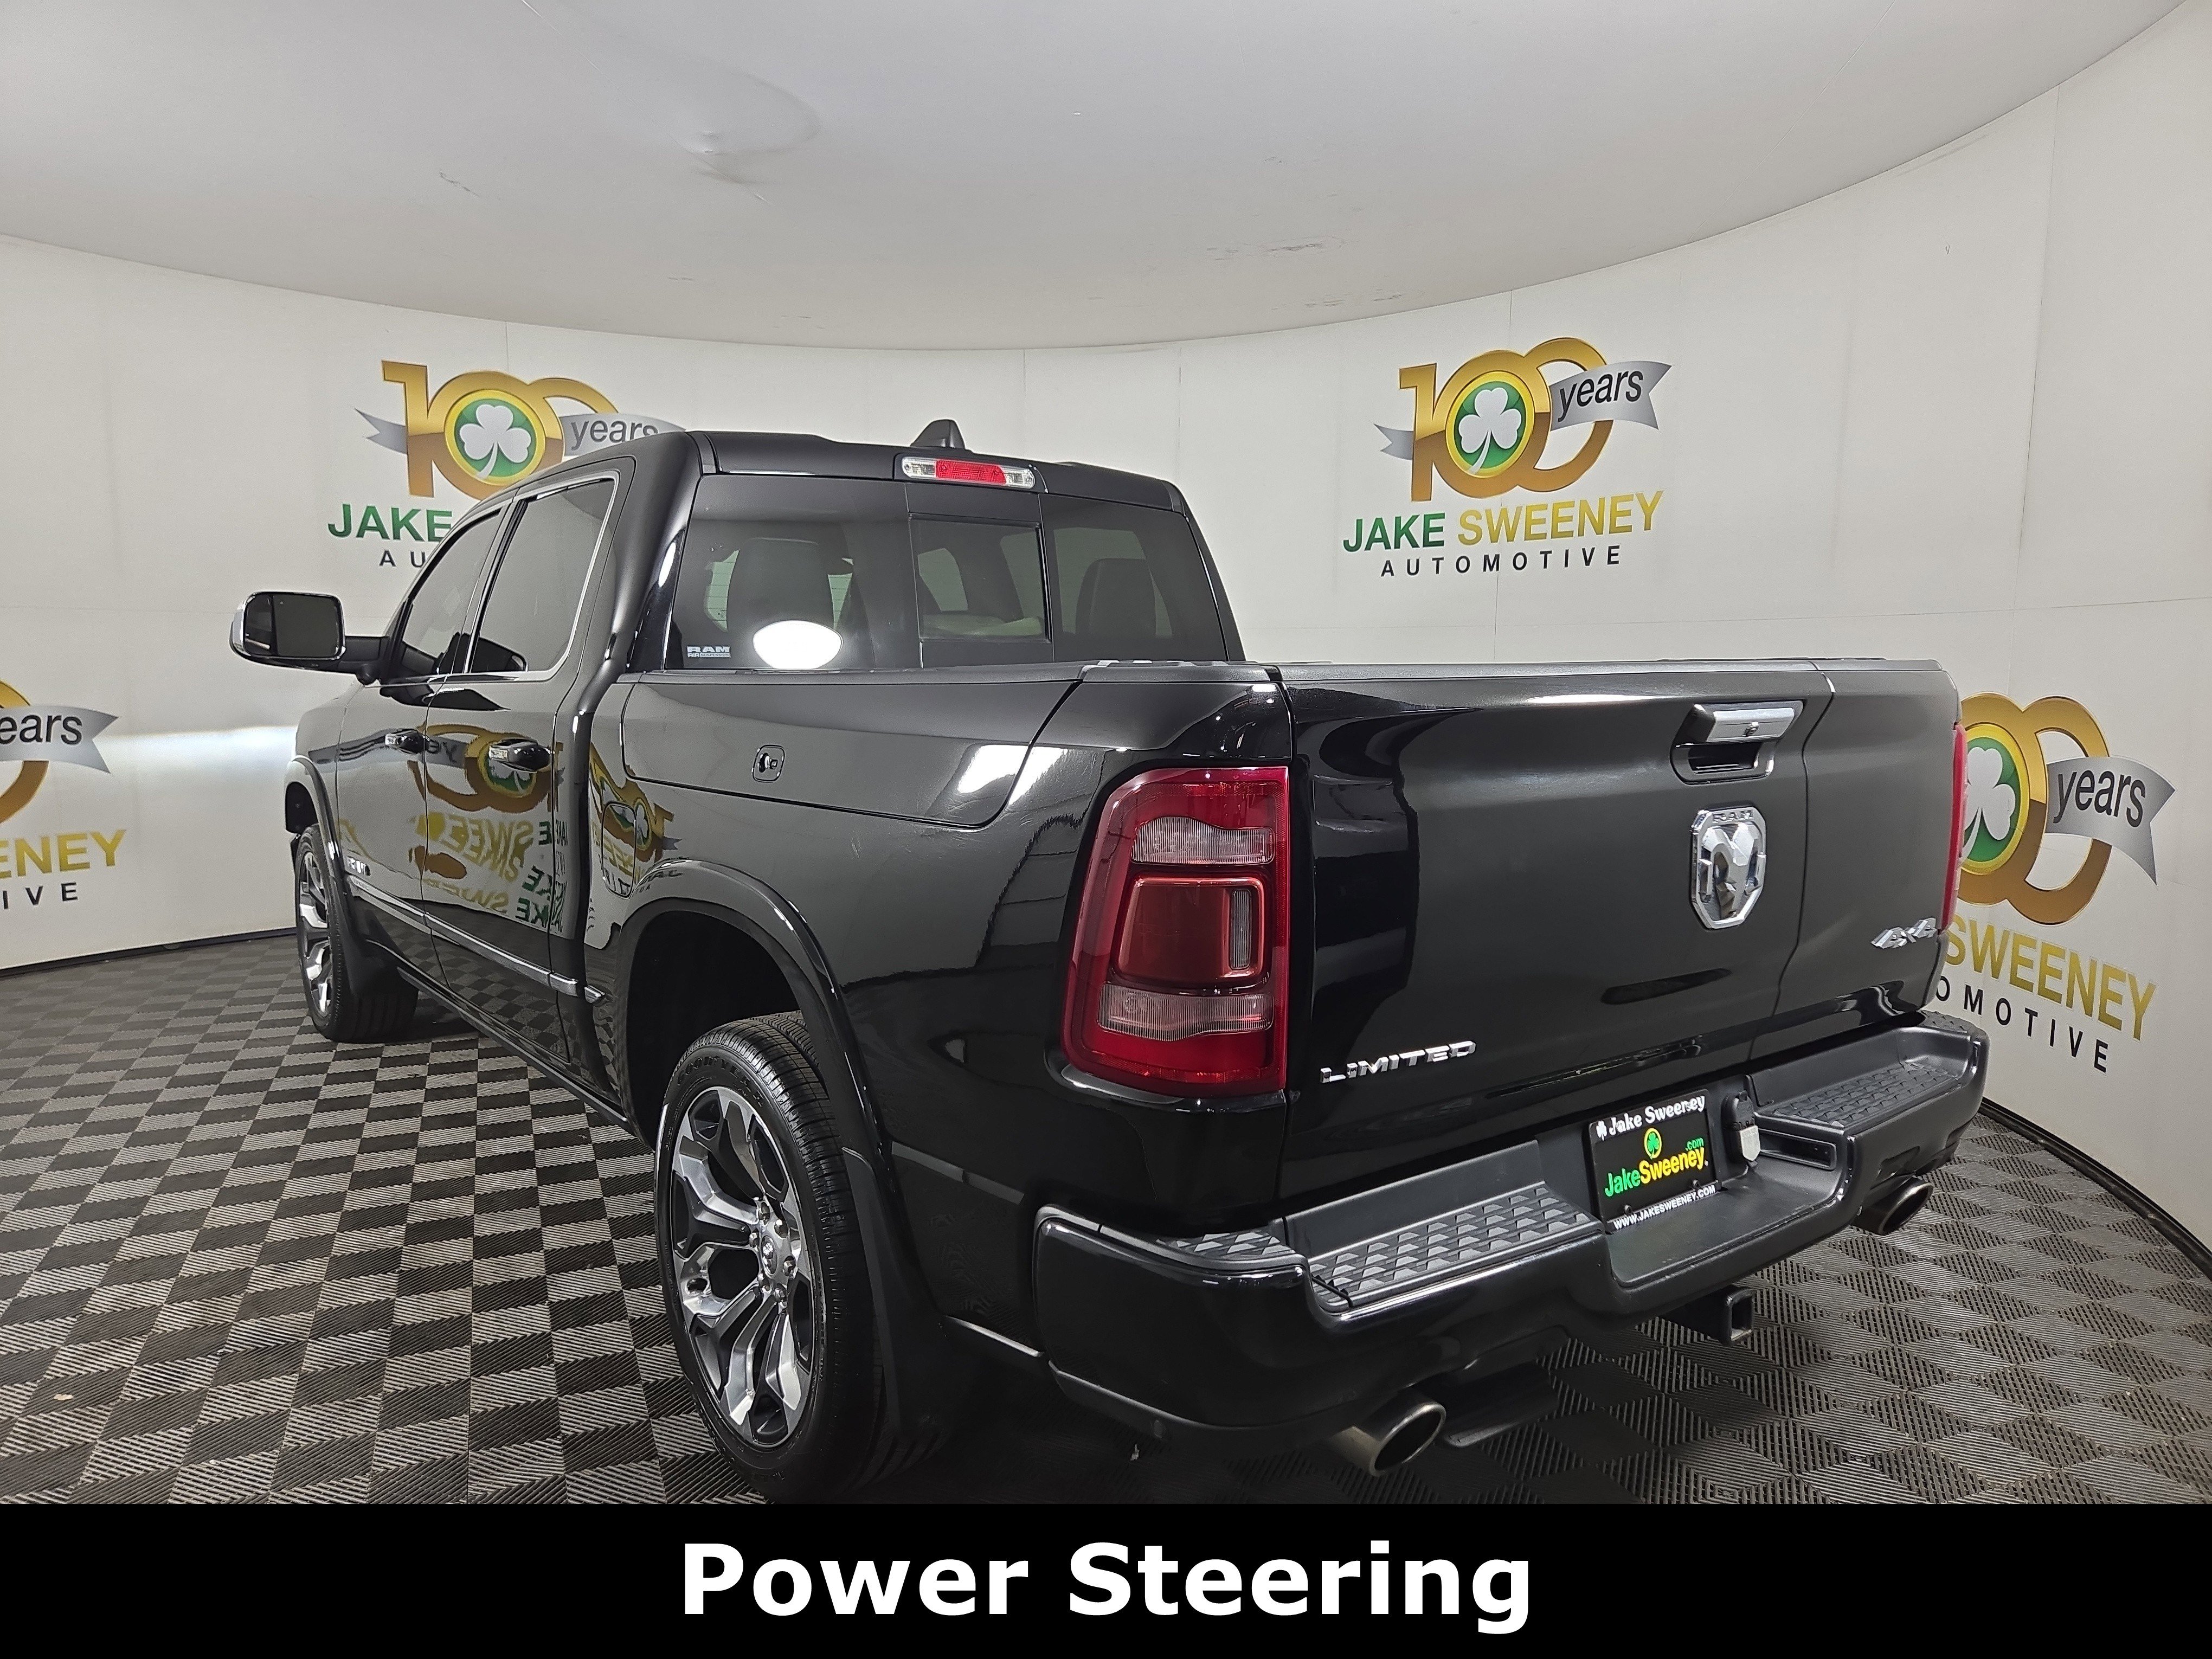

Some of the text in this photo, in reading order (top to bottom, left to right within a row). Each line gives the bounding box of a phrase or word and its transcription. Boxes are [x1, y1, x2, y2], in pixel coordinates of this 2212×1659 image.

[1558, 370, 1644, 423] years
[328, 504, 453, 543] JAKE
[1343, 490, 1664, 553] JAKE SWEENEY
[1381, 545, 1621, 577] AUTOMOTIVE
[1712, 809, 1754, 824] RAM
[2053, 769, 2146, 828] years
[1944, 914, 2157, 1041] SWEENEY
[1320, 1040, 1476, 1083] LIMITED
[1609, 1095, 1706, 1136] Jake Sweeney
[1613, 1184, 1716, 1230] WWW.JAKESWEENEY.COM
